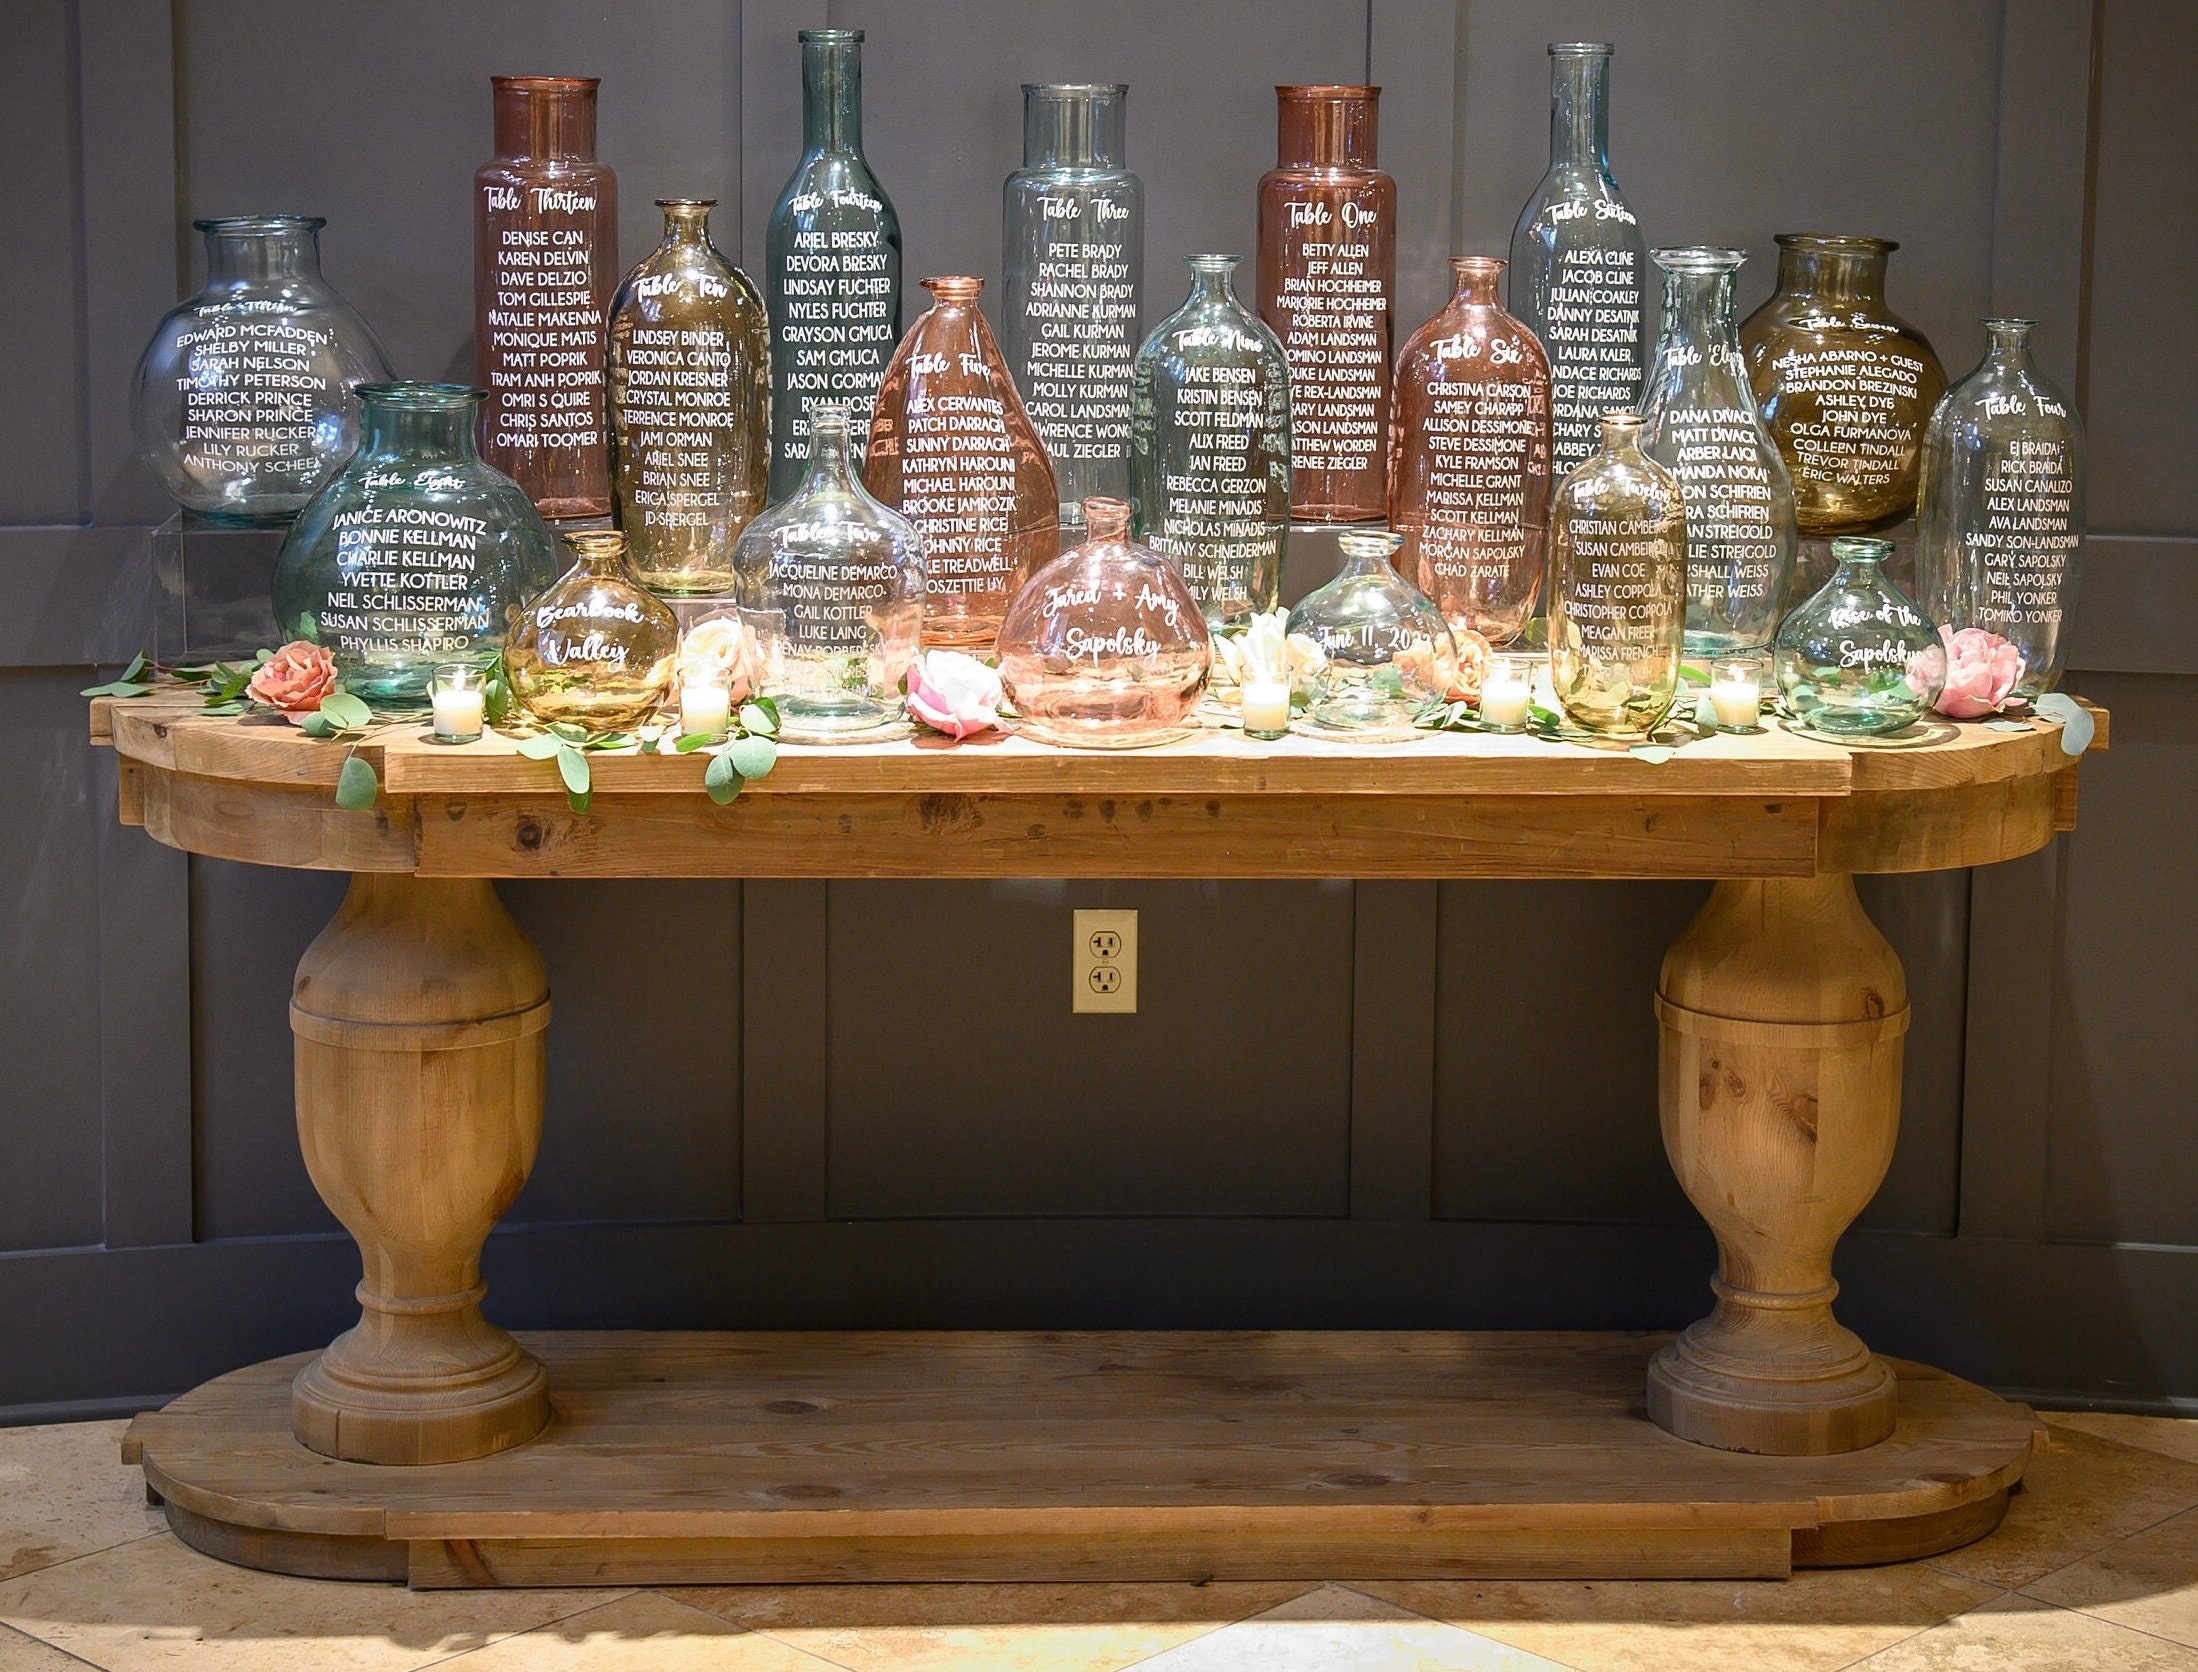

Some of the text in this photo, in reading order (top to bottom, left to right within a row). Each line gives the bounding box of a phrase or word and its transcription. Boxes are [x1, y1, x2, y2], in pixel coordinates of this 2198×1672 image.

[484, 186, 596, 215] Table Thirteen
[1037, 196, 1129, 221] Table Three
[1284, 202, 1376, 229] Table One
[503, 231, 583, 245] DENISE CAN
[794, 231, 878, 249] ARIEL BRESKY
[499, 251, 588, 265] KAREN DELVIN
[1049, 244, 1122, 259] PETE BRADY
[1303, 244, 1369, 258] BETTY ALLEN
[1564, 250, 1634, 266] ALEXA CLINE
[786, 254, 887, 271] DEVORA BRESKY
[1039, 263, 1128, 278] RACHEL BRADY
[1307, 262, 1363, 277] JEFF ALLEN
[501, 271, 586, 286] DAVE DELZIO
[1562, 269, 1634, 284] JACOB CLINE
[783, 278, 890, 295] LINDSAY FUCHTER
[498, 291, 590, 306] TOM GILLESPIE
[789, 302, 887, 319] NYLES FUCHTER
[1292, 315, 1374, 329] ROBERTA IRVINE
[176, 325, 327, 347] EDWARD MCFADDEN
[633, 330, 723, 346] LINDSEY BINDER
[1041, 324, 1124, 339] GAIL KURMAN
[1288, 333, 1377, 346] ADAM LANDSMAN
[194, 340, 306, 356] SHELBY MILLER
[1032, 343, 1130, 359] JEROME KURMAN
[1559, 346, 1631, 361] LAURA KALER
[627, 350, 684, 366] VERONICA
[906, 352, 950, 379] Table
[628, 371, 728, 387] JORDAN KREISNER
[1185, 367, 1255, 384] JAKE BENSEN
[1785, 364, 1916, 383] STEPHANIE ALEGADO
[1427, 382, 1531, 399] CHRISTINA CARSON
[1553, 383, 1630, 399] JOE RICHARDS
[1786, 379, 1917, 399] BRANDON BREZINSKI
[188, 392, 311, 406] DERRICK PRINCE
[1815, 395, 1895, 409] ASHLEY DYE
[1975, 395, 2066, 420] Table Four
[188, 410, 313, 422] SHARON PRINCE
[1174, 411, 1264, 428] SCOTT FELDMAN
[1670, 410, 1711, 424] DANA
[1822, 410, 1886, 424] JOHN DYE
[640, 431, 712, 447] JAMI ORMAN
[1672, 429, 1758, 445] MATT DIVACK
[1791, 422, 1911, 440] OLGA FURMANOVA
[1189, 434, 1248, 449] ALIX FREED
[903, 458, 1015, 473] KATHRYN HAROUNI
[1435, 455, 1518, 470] KYLE FRAMSON
[2001, 460, 2062, 474] RICK BRAIDA
[904, 477, 1015, 494] MICHAEL HAROUNI
[1167, 477, 1266, 494] REBECCA GERZON
[1430, 473, 1522, 488] MICHELLE GRANT
[1985, 479, 2072, 493] SUSAN CANALIZO
[1710, 485, 1771, 500] SCHIFRIEN
[903, 498, 1016, 514] BROOKE JAMROZIK
[1987, 498, 2070, 512] ALEX LANDSMAN
[333, 509, 486, 535] JANICE ARONOWITZ
[1430, 510, 1518, 524] SCOTT KELLMAN
[1711, 544, 1776, 559] STREIGOLD
[769, 563, 897, 580] JACQUELINE DEMARCO
[1593, 563, 1645, 577] EVAN COE
[1734, 564, 1768, 578] WEISS
[342, 573, 468, 590] YVETTE KOTTLER
[783, 583, 883, 600] MONA DEMARCO
[1575, 584, 1611, 598] ASHLEY
[1727, 584, 1763, 598] WEISS
[1991, 590, 2056, 604] PHIL YONKER
[328, 592, 480, 612] NEIL SCHLISSERMAN
[1043, 582, 1179, 626] Jared + Amy
[794, 605, 872, 620] GAIL KOTTLER
[1564, 603, 1672, 619] CHRISTOPHER COPPOLA
[800, 625, 866, 640] LUKE LAING
[1316, 626, 1354, 650] June
[341, 636, 468, 651] PHYLLIS SHAPIRO
[1064, 626, 1161, 668] Sapolsky
[550, 633, 629, 673] Valley
